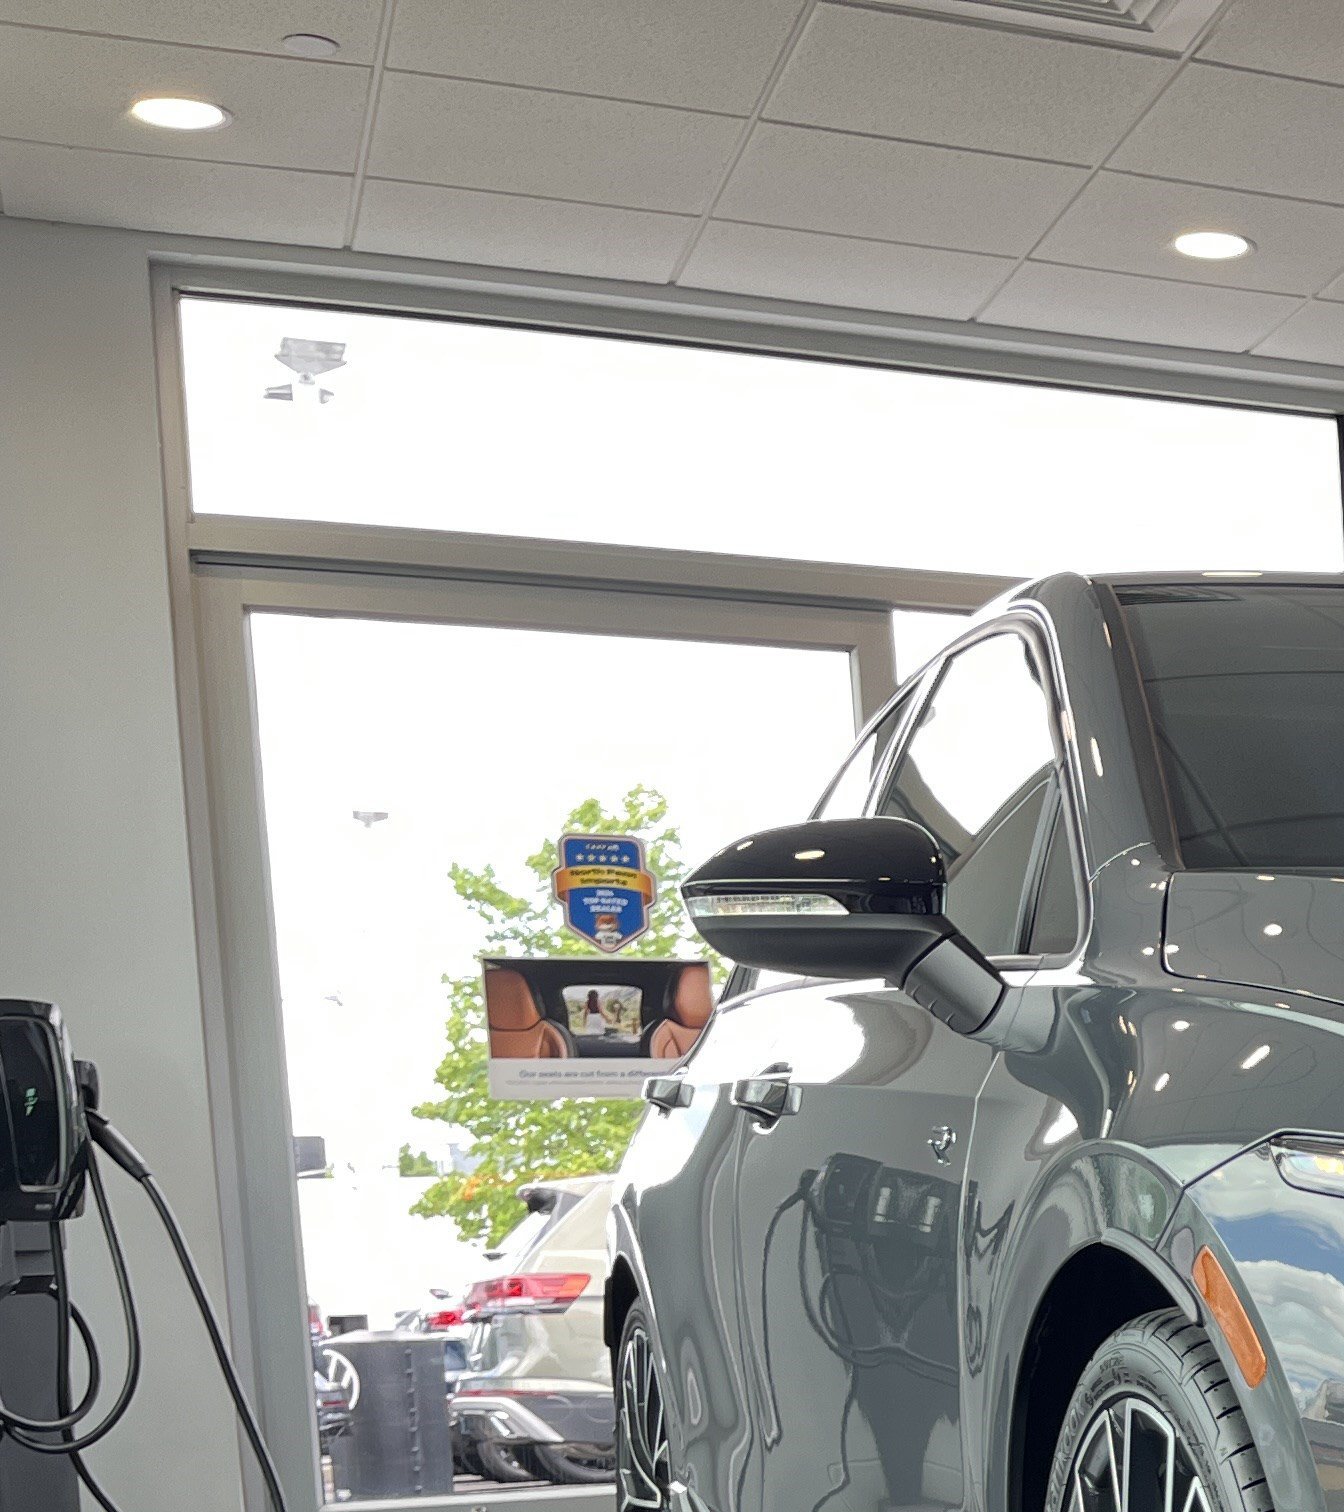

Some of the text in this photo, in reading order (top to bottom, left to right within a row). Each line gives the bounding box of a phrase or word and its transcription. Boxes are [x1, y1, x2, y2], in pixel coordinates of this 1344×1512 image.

[519, 1069, 537, 1079] Our
[539, 1070, 562, 1078] seats
[596, 1069, 618, 1078] from
